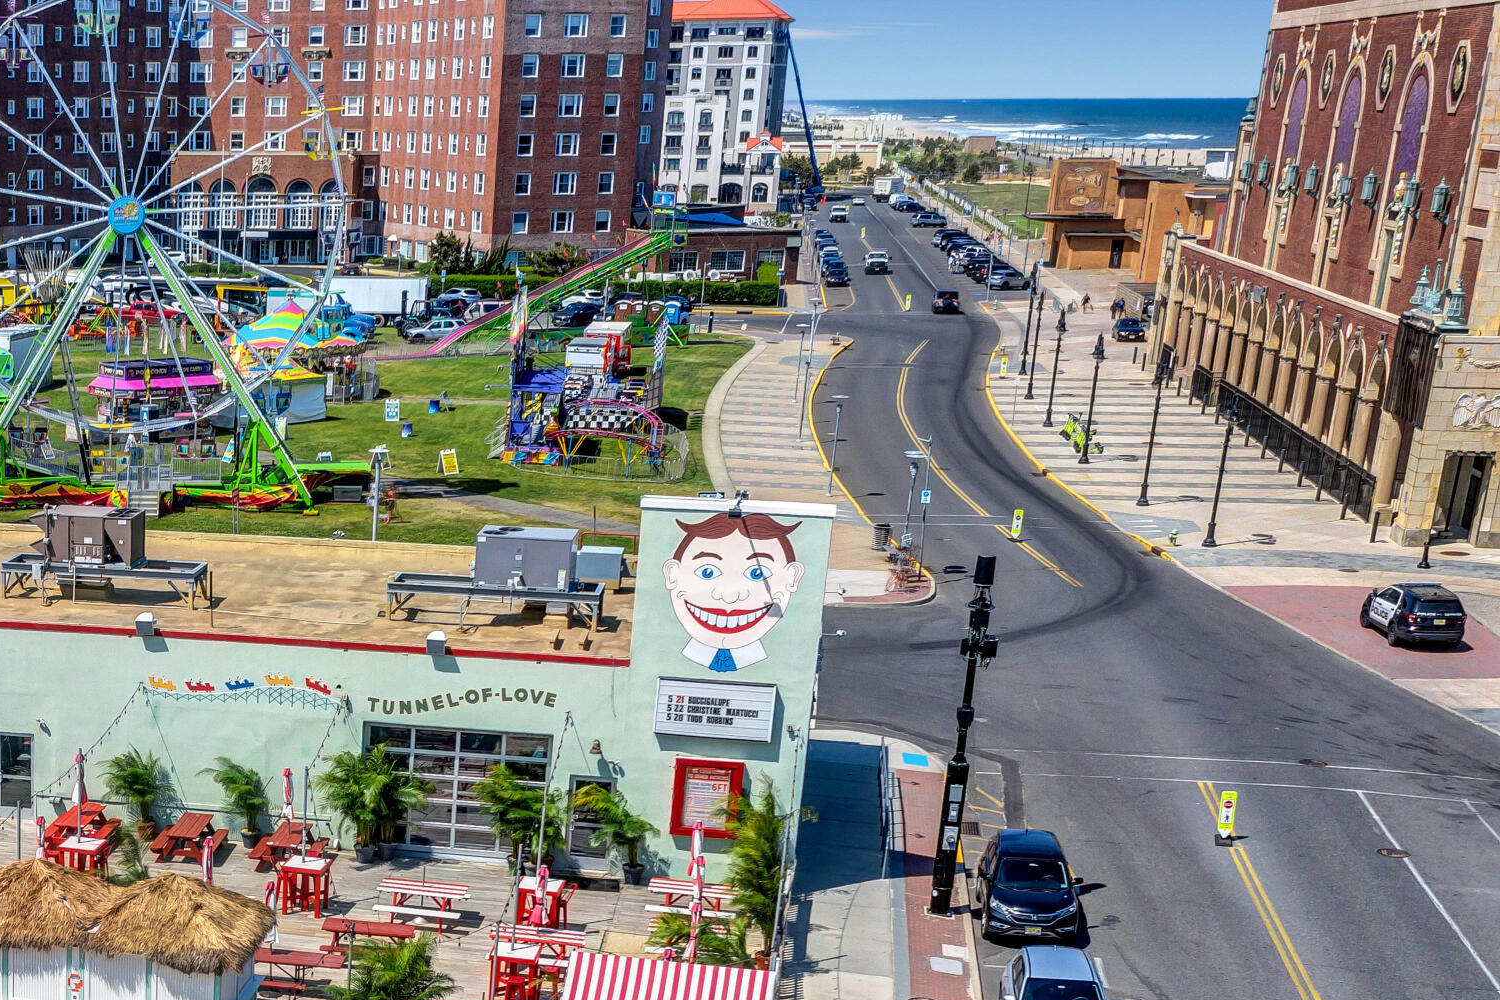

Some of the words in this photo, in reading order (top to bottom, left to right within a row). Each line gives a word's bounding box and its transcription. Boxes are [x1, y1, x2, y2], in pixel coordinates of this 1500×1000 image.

[1370, 606, 1389, 620] POLICE
[667, 695, 674, 703] 5
[675, 695, 685, 704] 21
[666, 704, 672, 712] 5
[673, 704, 684, 713] 22
[686, 705, 722, 716] CHRISTINE
[725, 707, 759, 719] MARTUCCI
[665, 713, 672, 721] 5
[686, 714, 703, 724] TODD
[706, 715, 734, 726] ROBBINS
